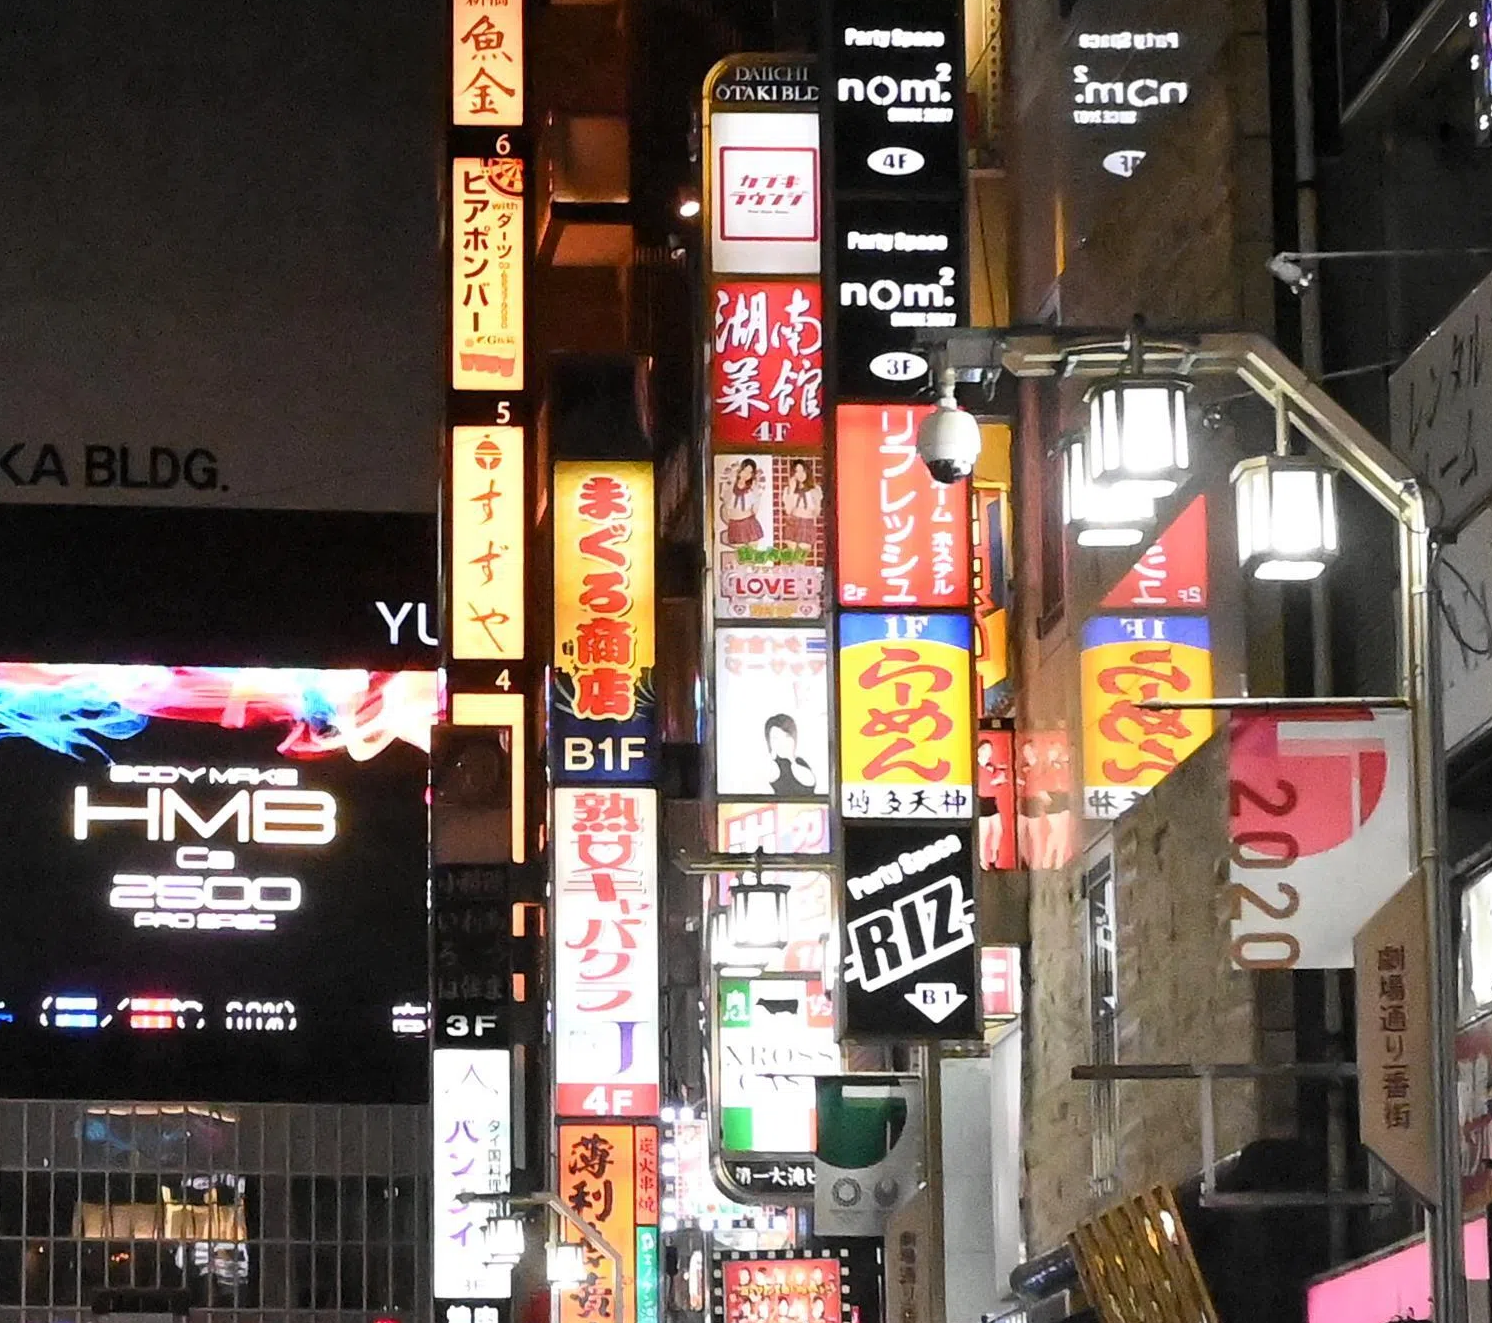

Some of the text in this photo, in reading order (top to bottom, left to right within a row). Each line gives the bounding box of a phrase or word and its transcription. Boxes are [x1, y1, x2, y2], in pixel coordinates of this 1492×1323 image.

[460, 15, 516, 115] 魚金
[496, 135, 511, 155] 6
[882, 153, 907, 169] 4F
[492, 201, 518, 211] with
[463, 170, 490, 332] ビアポンバー
[496, 212, 513, 259] ダーツ
[715, 287, 822, 357] 湖南
[886, 359, 912, 374] 3F
[496, 401, 510, 423] 5
[751, 423, 790, 442] 4F
[84, 444, 230, 491] BLDG.
[878, 408, 919, 603] リフレッシュ
[466, 478, 512, 653] すずや
[575, 475, 634, 720] まぐろ商店
[736, 577, 795, 596] LOVE
[843, 583, 868, 601] 2F
[884, 616, 929, 640] 1F
[495, 669, 511, 691] 4
[859, 648, 954, 783] らーめん
[563, 737, 646, 772] B1F
[109, 765, 207, 784] BODY
[74, 786, 338, 845] HMB
[1230, 778, 1300, 970] 2020
[109, 875, 303, 911] 2500
[854, 878, 970, 986] RIZ
[445, 1014, 497, 1037] 3F
[581, 1085, 633, 1116] 4F
